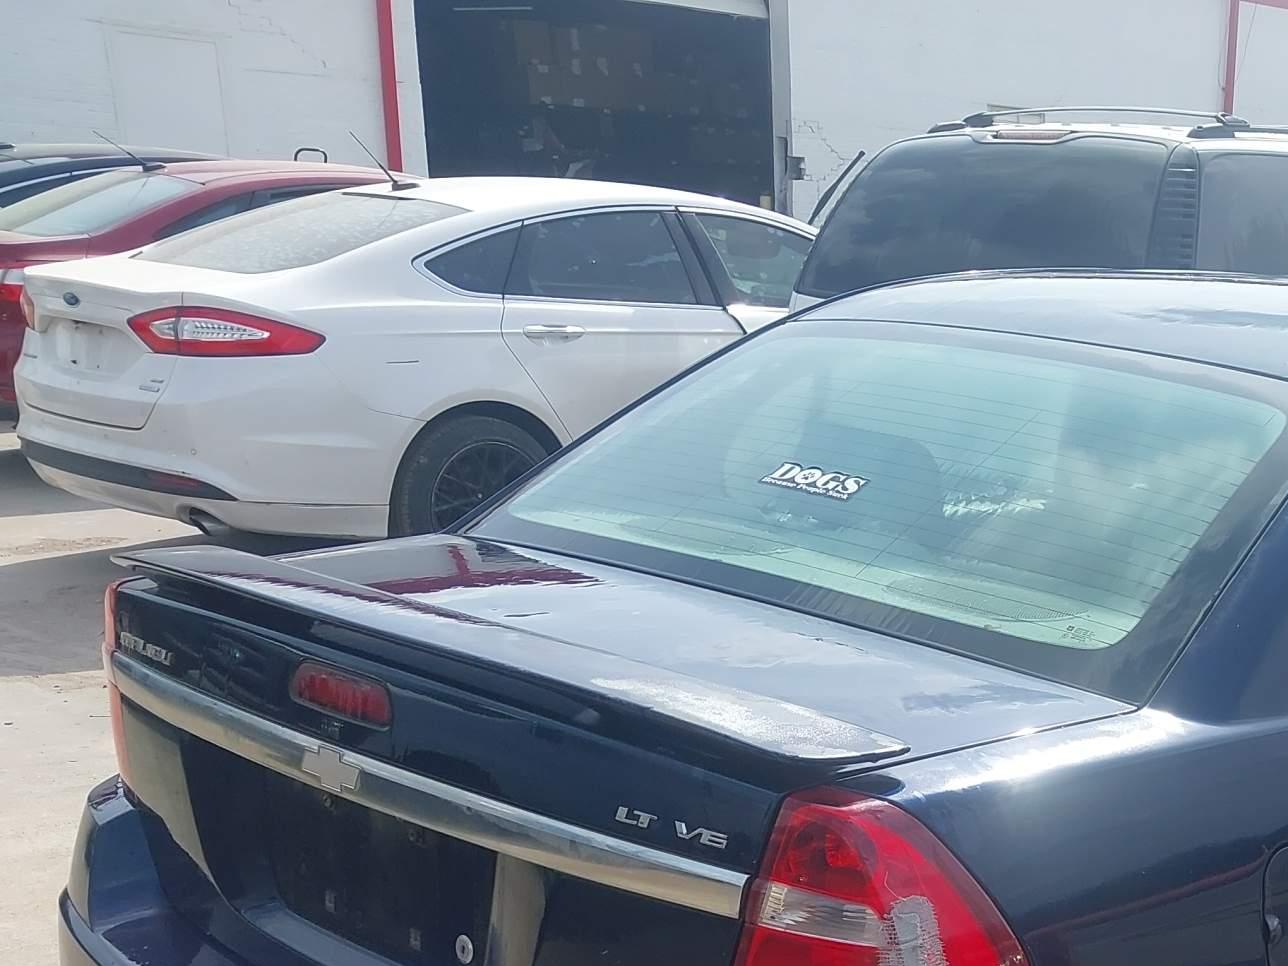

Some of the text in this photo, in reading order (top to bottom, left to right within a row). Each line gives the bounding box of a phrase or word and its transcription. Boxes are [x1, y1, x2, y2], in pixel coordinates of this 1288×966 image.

[768, 462, 868, 494] DOGS
[615, 806, 728, 849] LT V6
